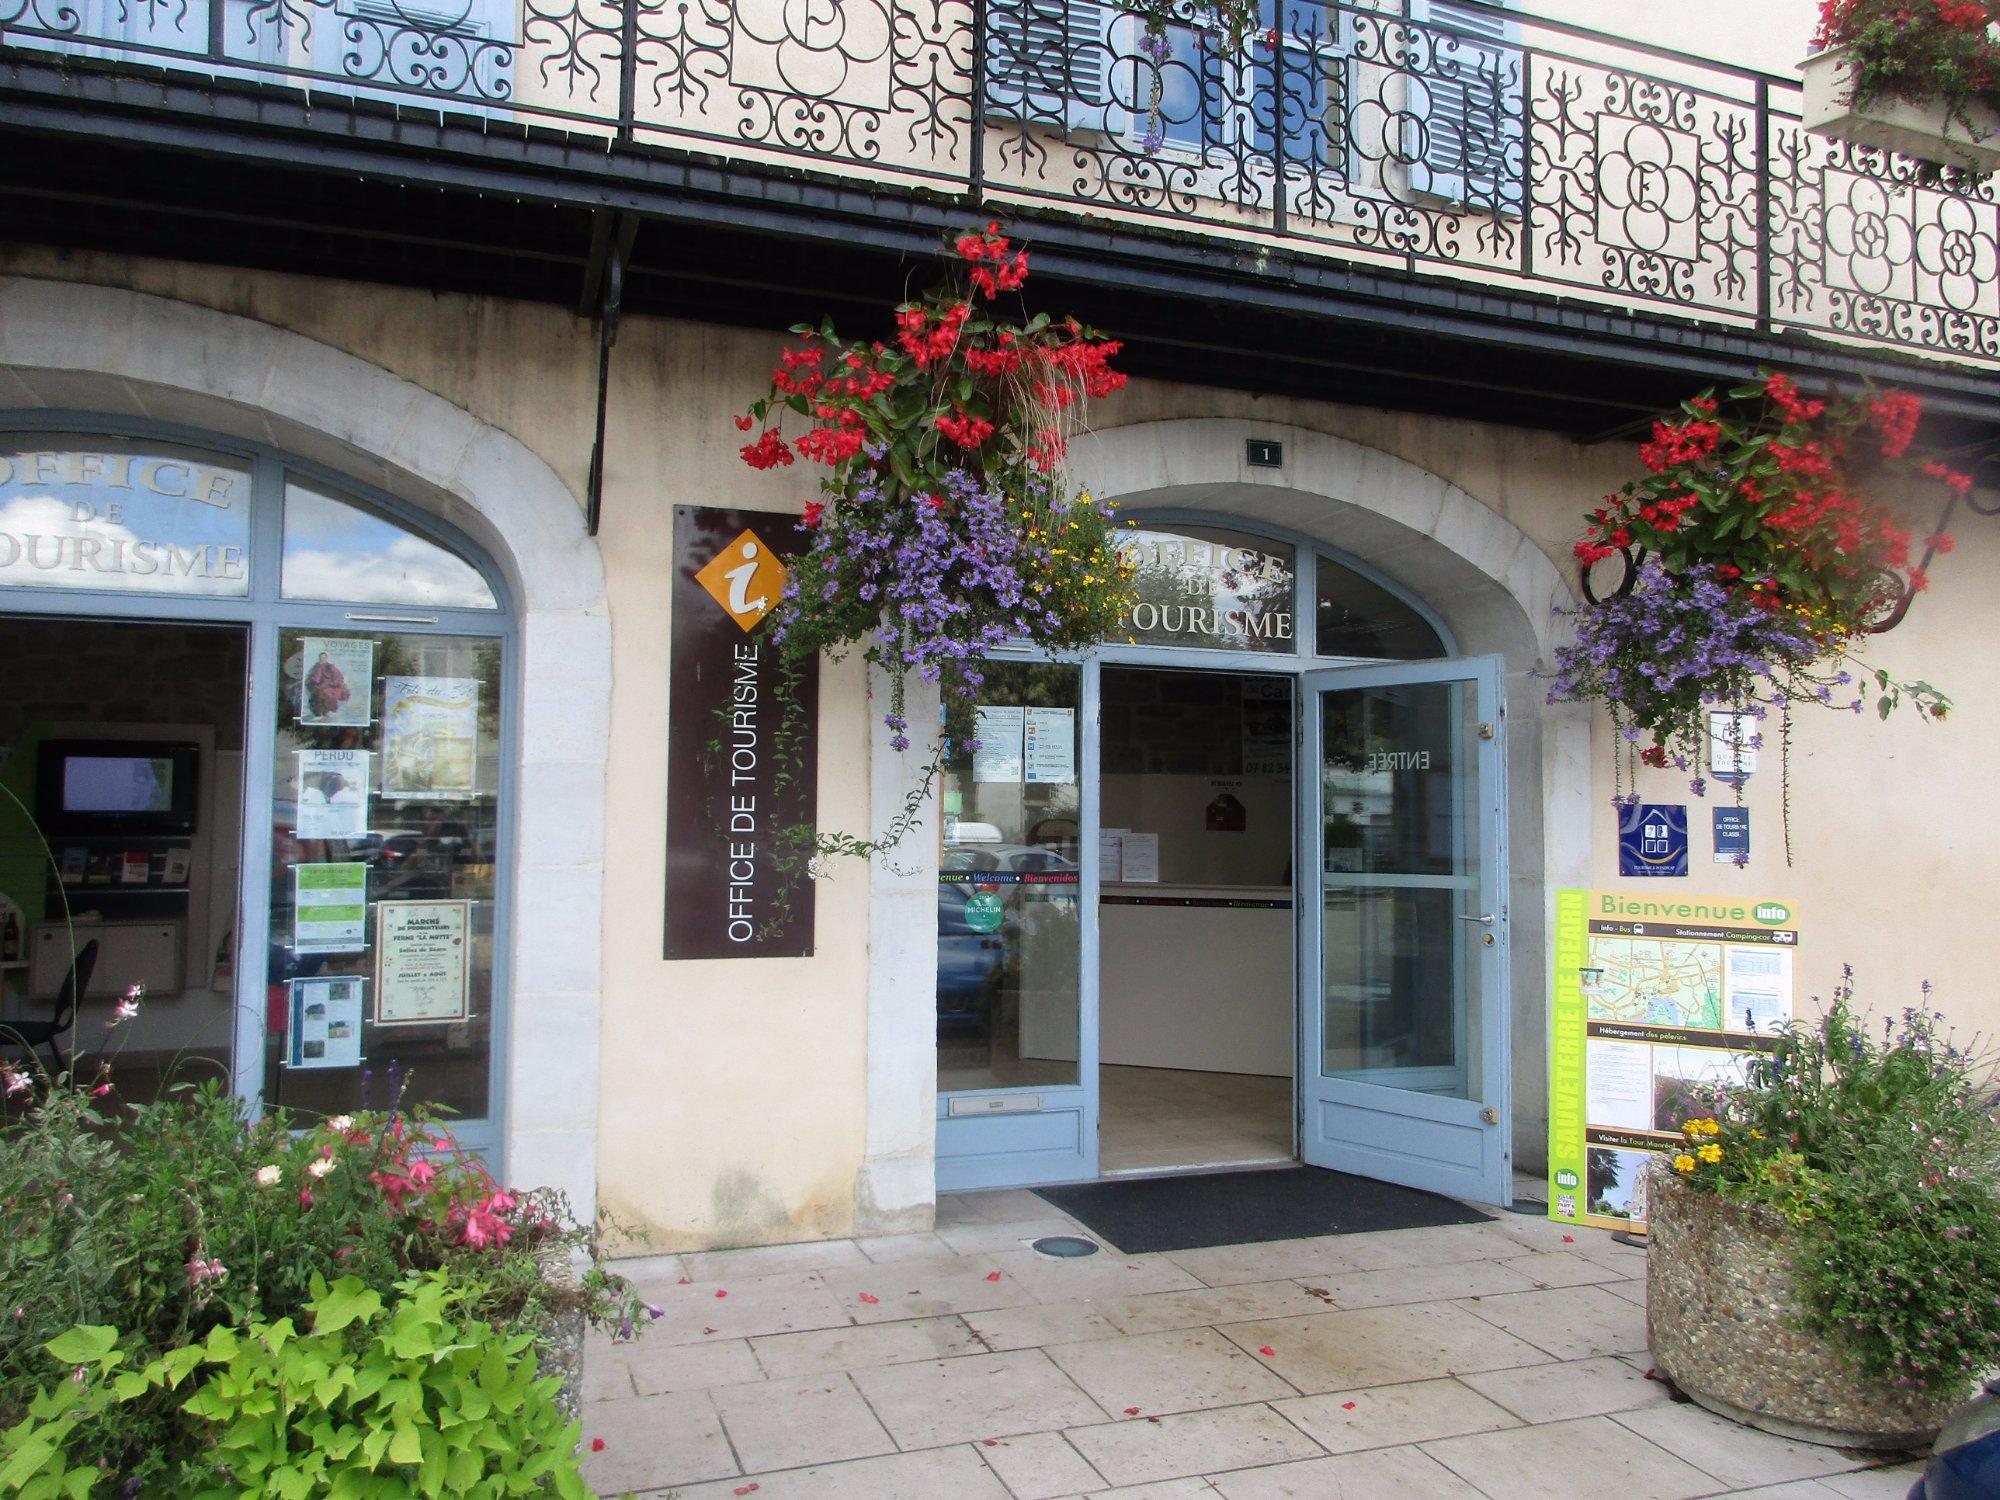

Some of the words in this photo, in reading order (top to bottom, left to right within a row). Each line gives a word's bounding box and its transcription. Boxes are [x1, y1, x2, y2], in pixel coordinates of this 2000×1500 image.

[1262, 447, 1270, 461] 1
[69, 500, 124, 525] DE
[1116, 602, 1293, 640] OURISME
[323, 640, 370, 650] VOYAGES
[731, 643, 759, 788] TOURISME
[314, 751, 354, 761] PERDU
[731, 795, 756, 833] DE
[973, 873, 1014, 882] Welcome
[1024, 874, 1078, 883] Bienvenidos
[728, 841, 755, 943] OFFICE
[1601, 894, 1746, 921] Bienvenue
[1756, 905, 1786, 919] info
[1600, 924, 1614, 932] Info
[1675, 928, 1724, 938] Stationnement
[1725, 932, 1771, 941] Camping-car
[1558, 969, 1581, 1004] DE
[1599, 1026, 1645, 1037] Hébergement
[1555, 1005, 1581, 1159] SAUVETERRE
[1598, 1134, 1619, 1143] Visiter
[1629, 1137, 1645, 1146] Tour
[1557, 1172, 1577, 1185] info
